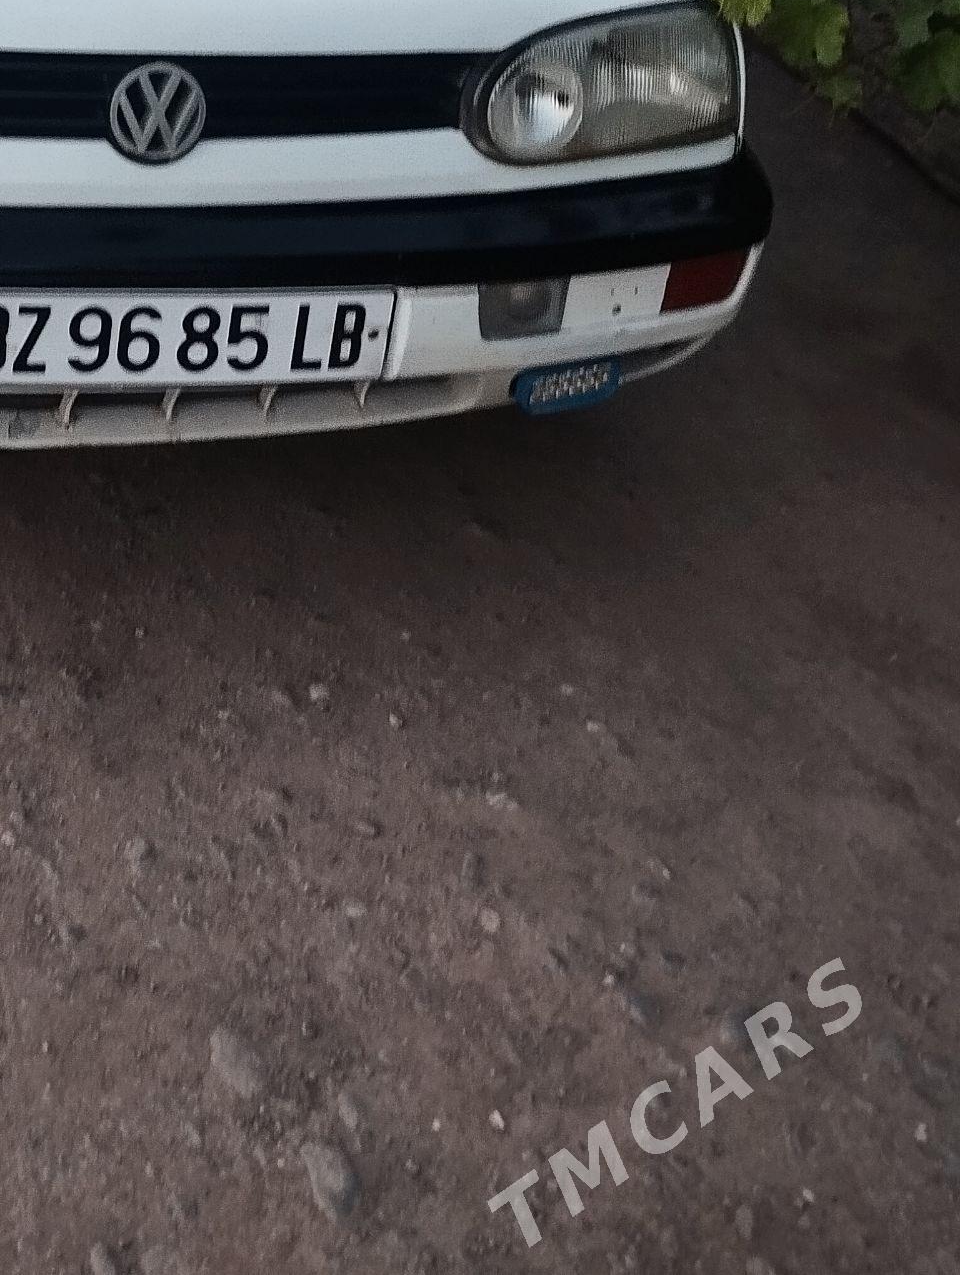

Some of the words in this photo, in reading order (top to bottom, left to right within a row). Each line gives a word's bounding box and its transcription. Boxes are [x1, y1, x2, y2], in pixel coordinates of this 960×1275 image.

[67, 304, 163, 373] 96
[175, 304, 271, 372] 85
[289, 301, 367, 371] LB
